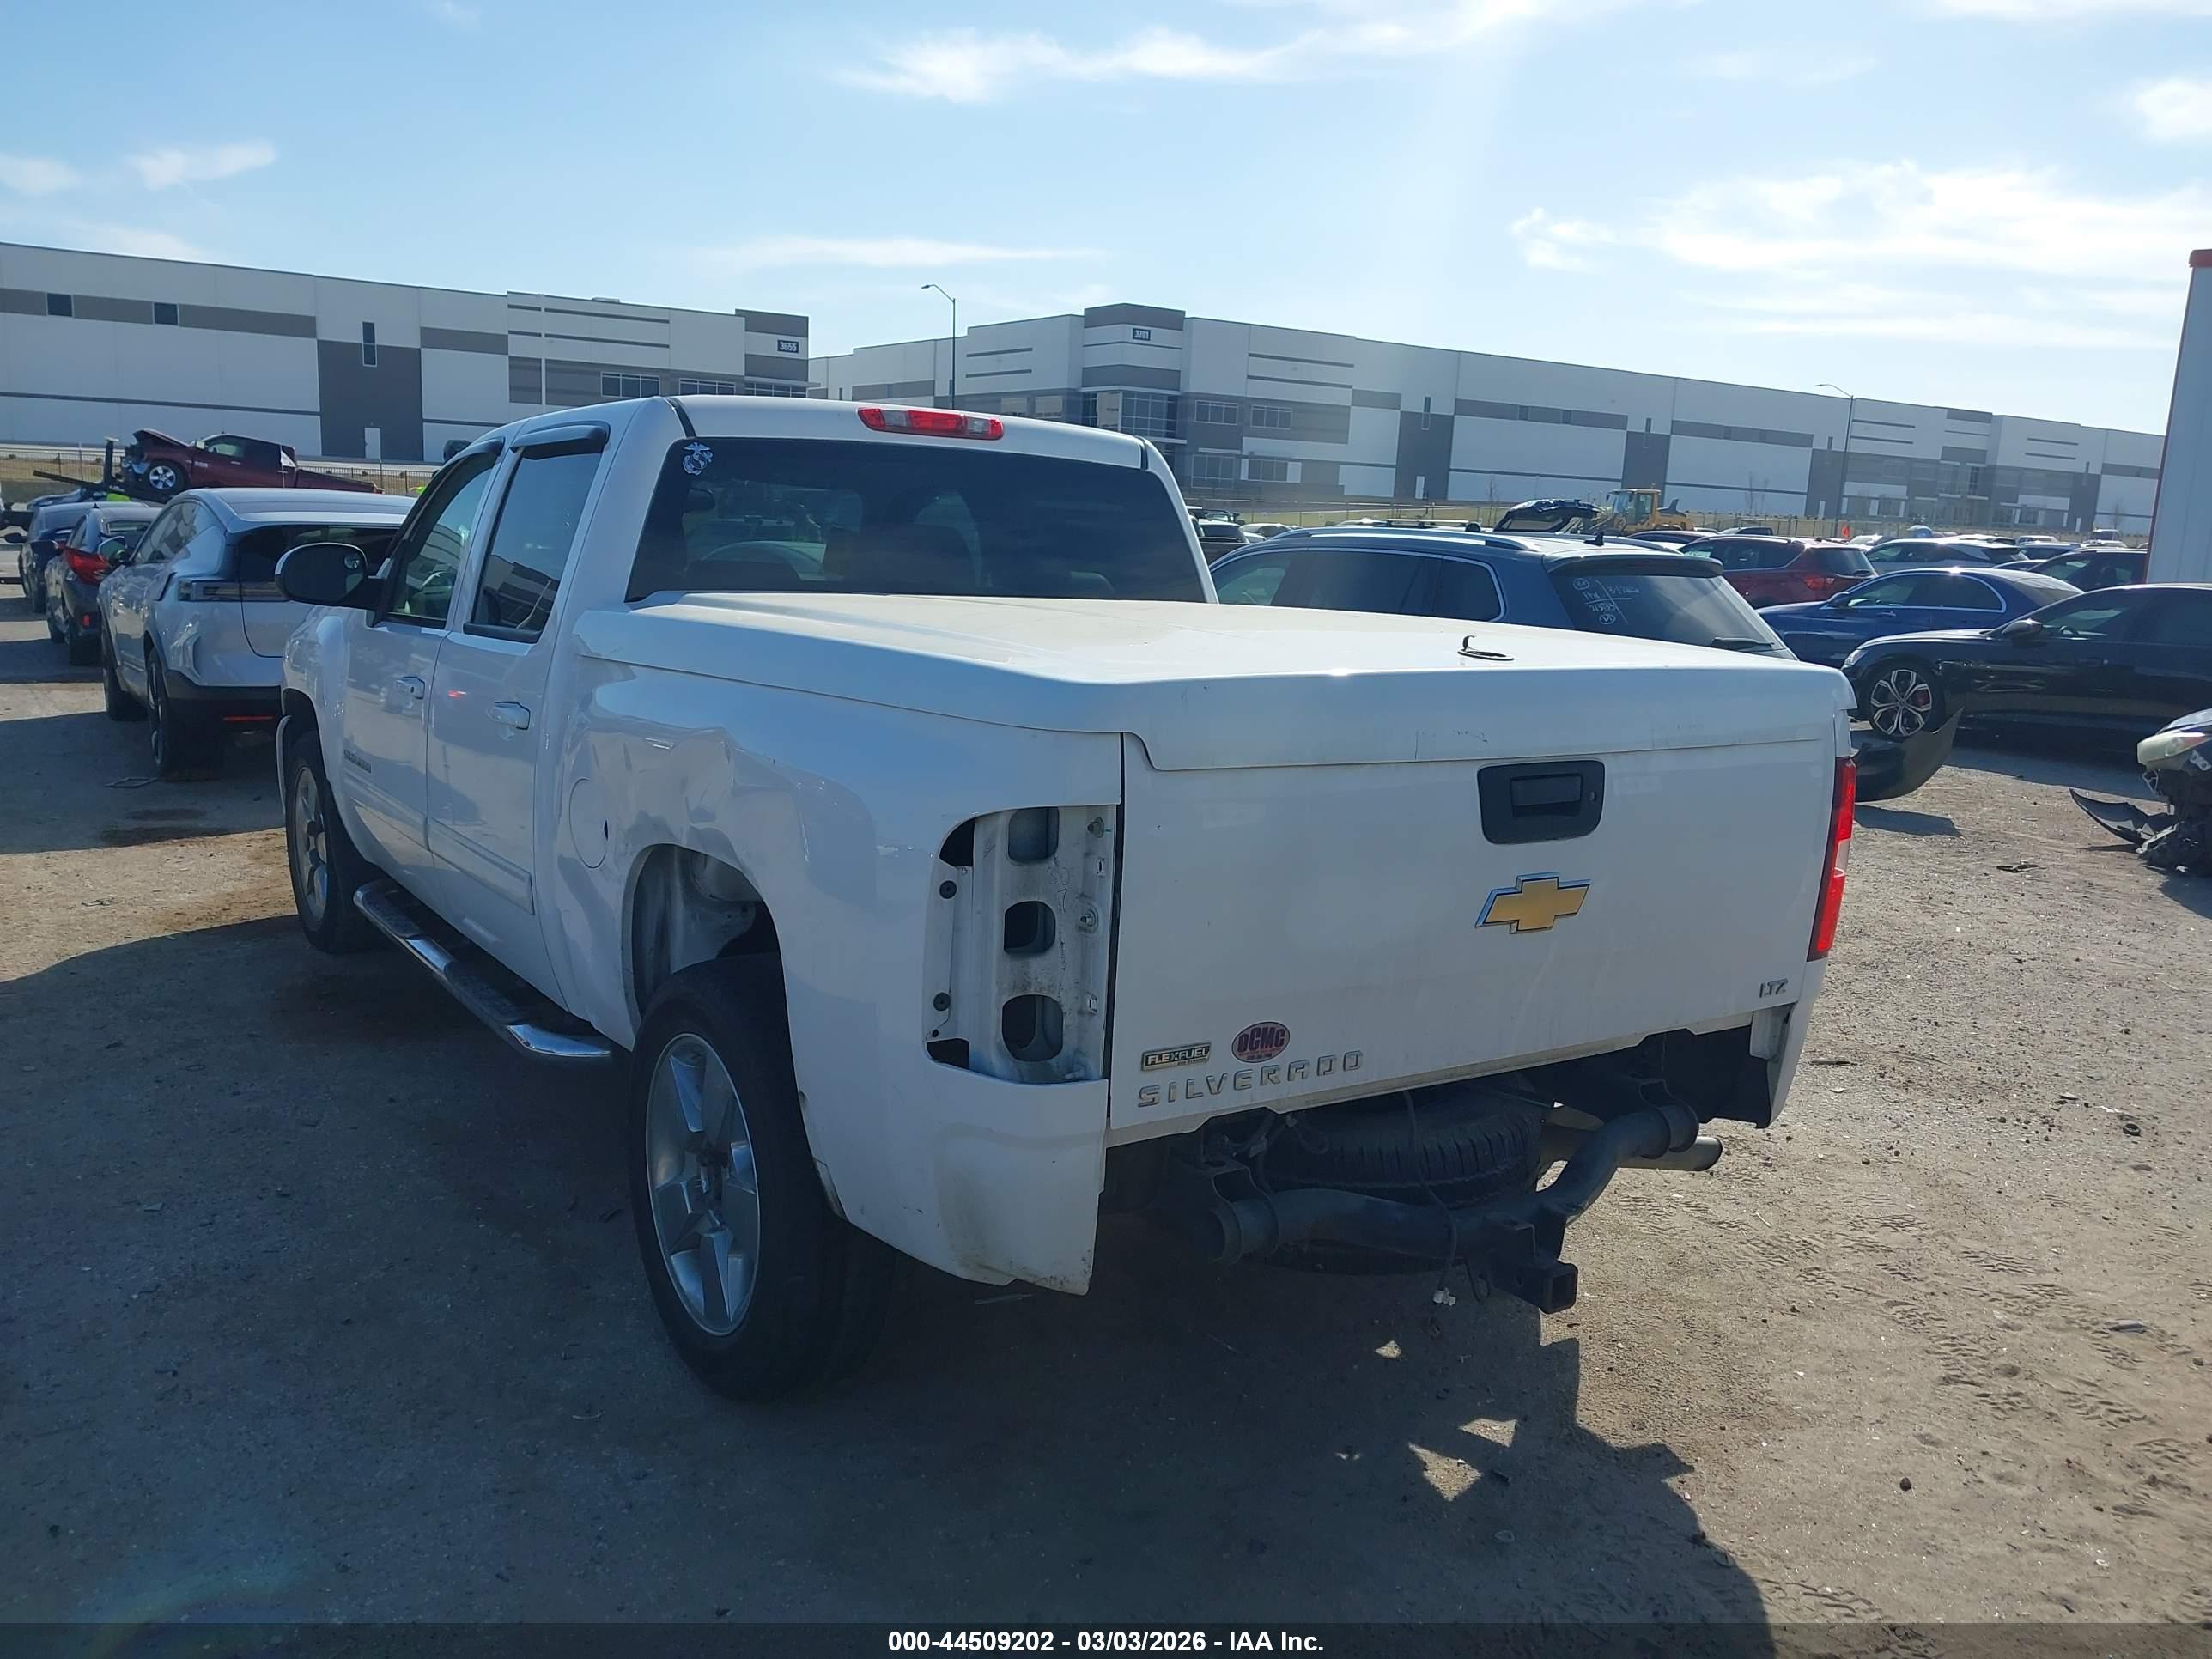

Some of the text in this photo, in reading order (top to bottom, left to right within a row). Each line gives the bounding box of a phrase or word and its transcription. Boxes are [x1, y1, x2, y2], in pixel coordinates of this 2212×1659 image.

[1759, 978, 1789, 998] LTZ
[1146, 1046, 1209, 1066] FLEXFUEL
[1138, 1050, 1364, 1108] SILVERADO
